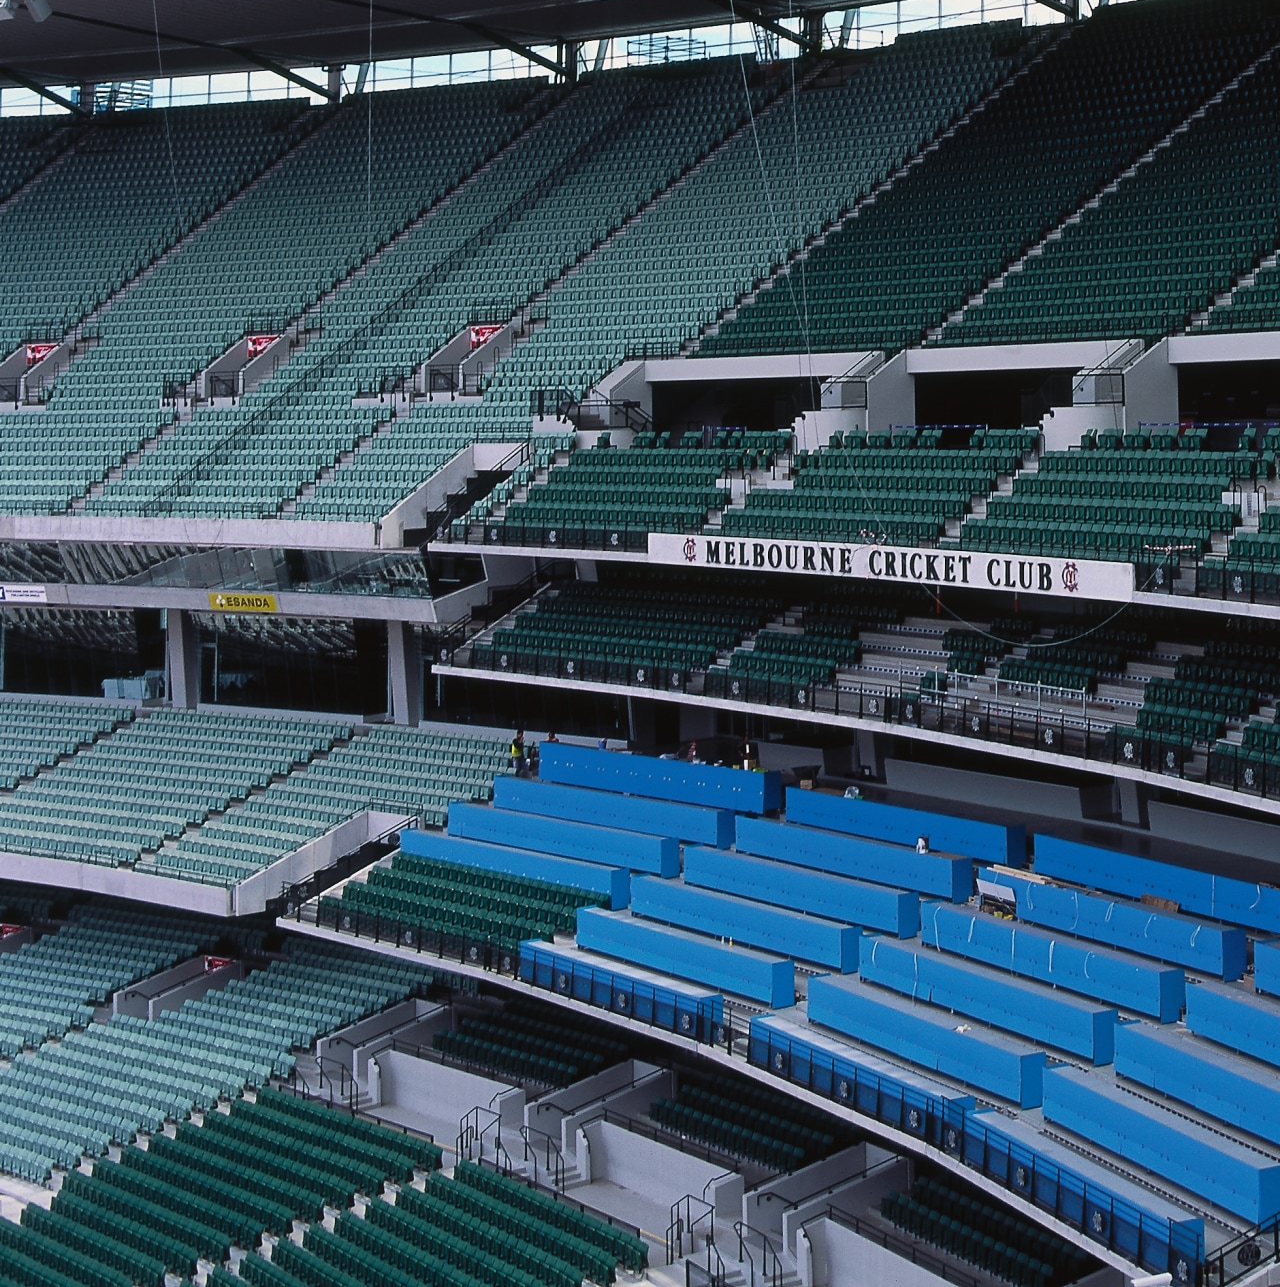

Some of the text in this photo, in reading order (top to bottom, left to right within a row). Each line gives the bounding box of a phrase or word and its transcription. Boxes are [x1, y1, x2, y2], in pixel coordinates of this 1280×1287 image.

[705, 540, 853, 575] MELBOURNE
[868, 549, 972, 584] CRICKET
[986, 559, 1053, 592] CLUB
[226, 597, 270, 608] ESANDA
